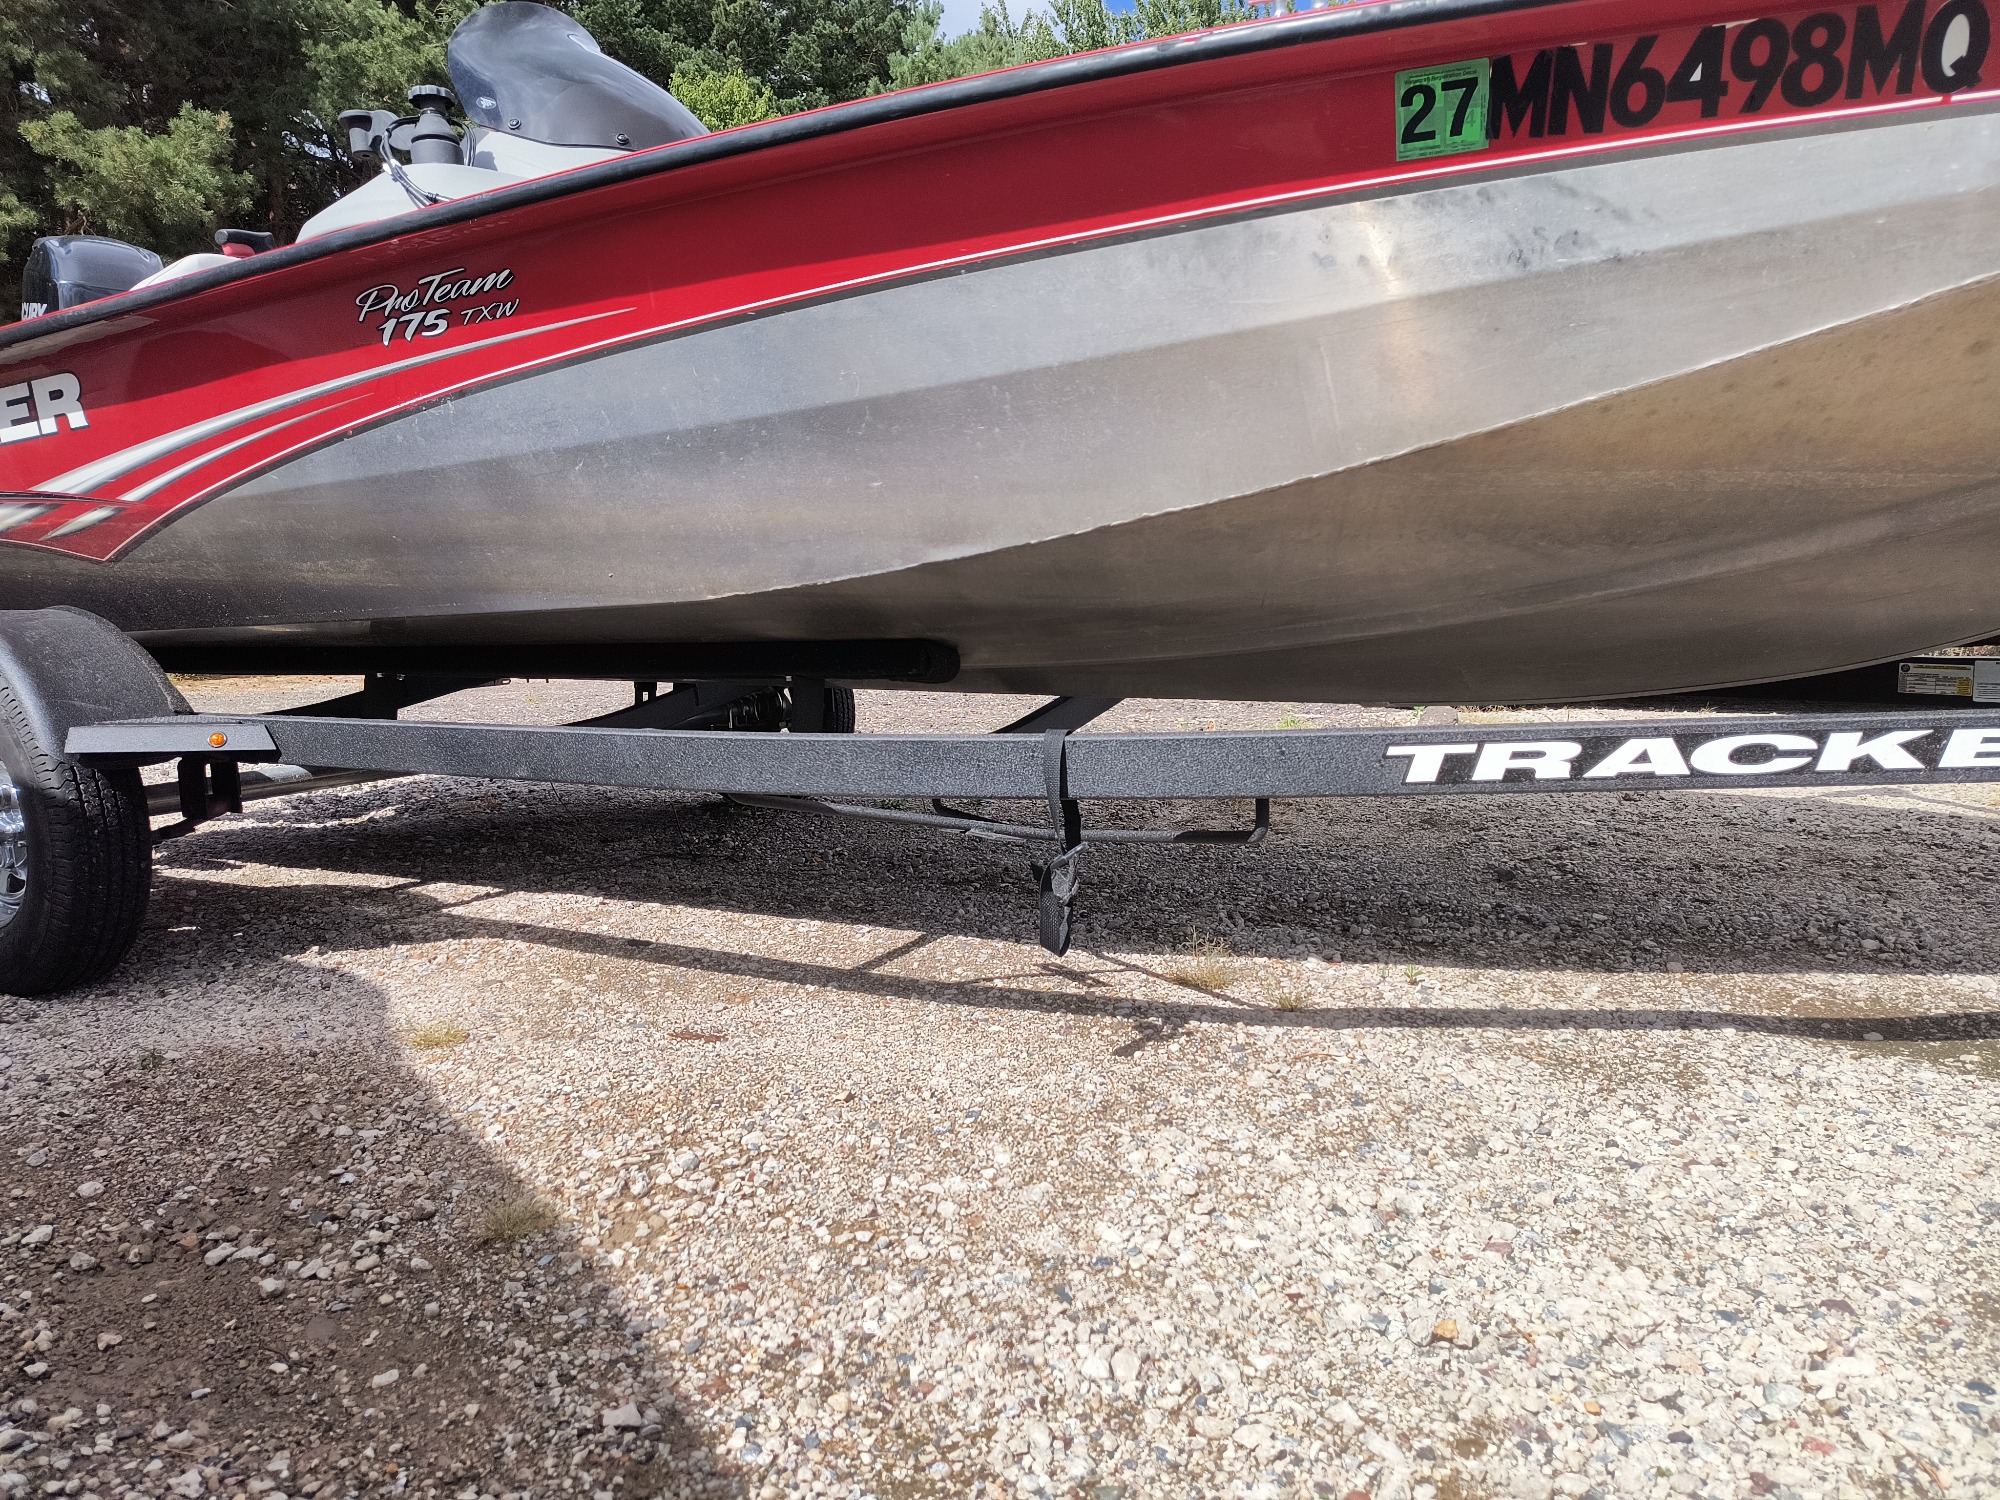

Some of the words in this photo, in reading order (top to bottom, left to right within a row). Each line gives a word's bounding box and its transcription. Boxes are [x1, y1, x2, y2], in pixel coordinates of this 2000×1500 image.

[1486, 0, 1991, 139] MN6498MQ
[1400, 76, 1479, 144] 27
[379, 308, 451, 347] 175
[460, 299, 520, 326] TXW
[1384, 727, 2000, 784] TRACKE
